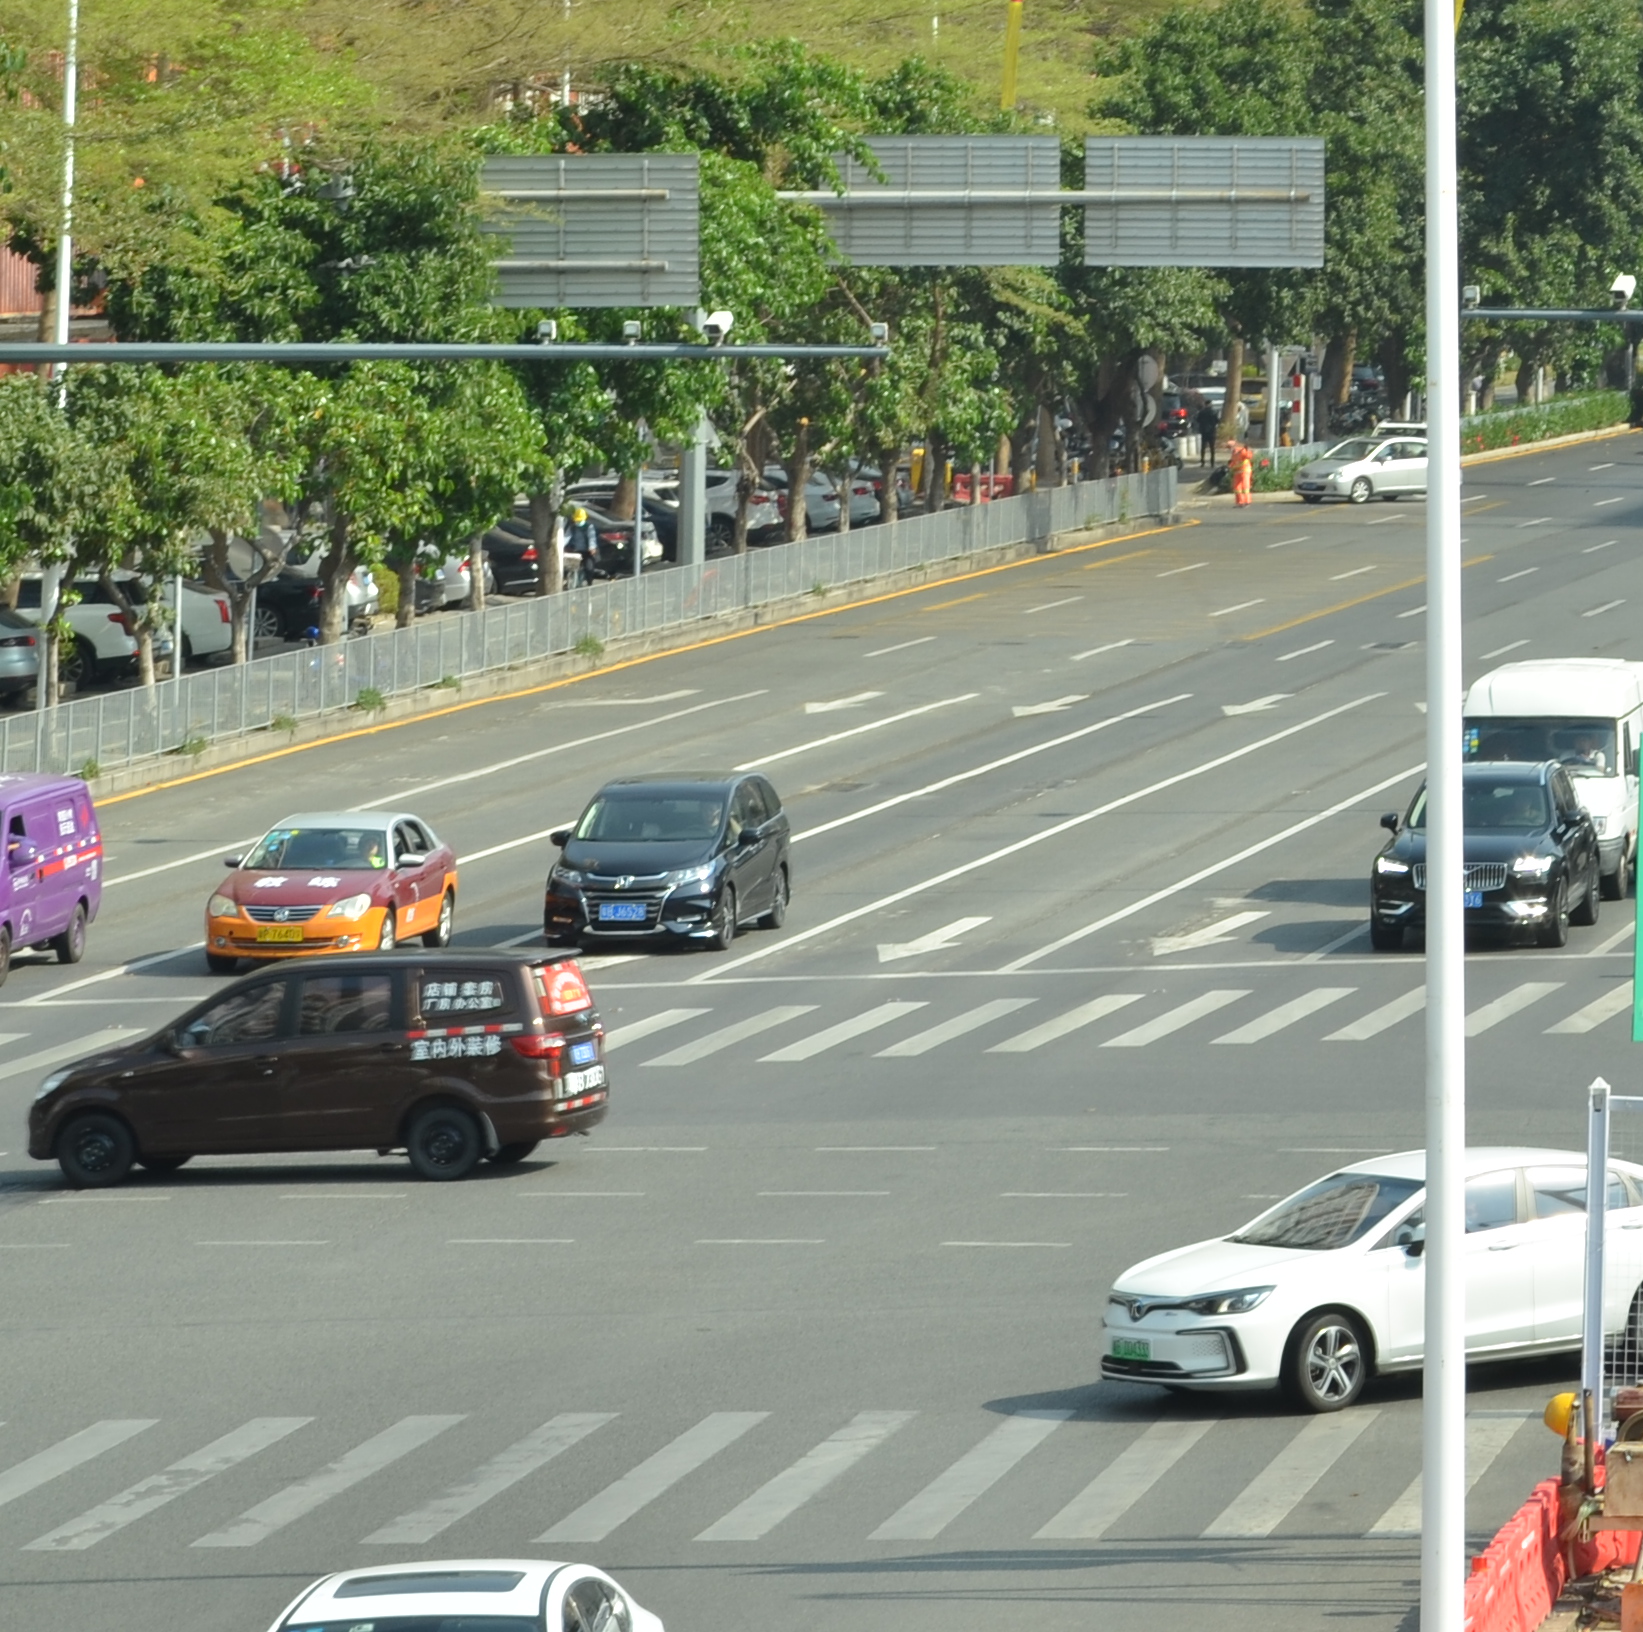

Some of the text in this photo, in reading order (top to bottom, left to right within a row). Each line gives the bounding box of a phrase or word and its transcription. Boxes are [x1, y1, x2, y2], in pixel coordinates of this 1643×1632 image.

[409, 1034, 502, 1061] 室内外装修
